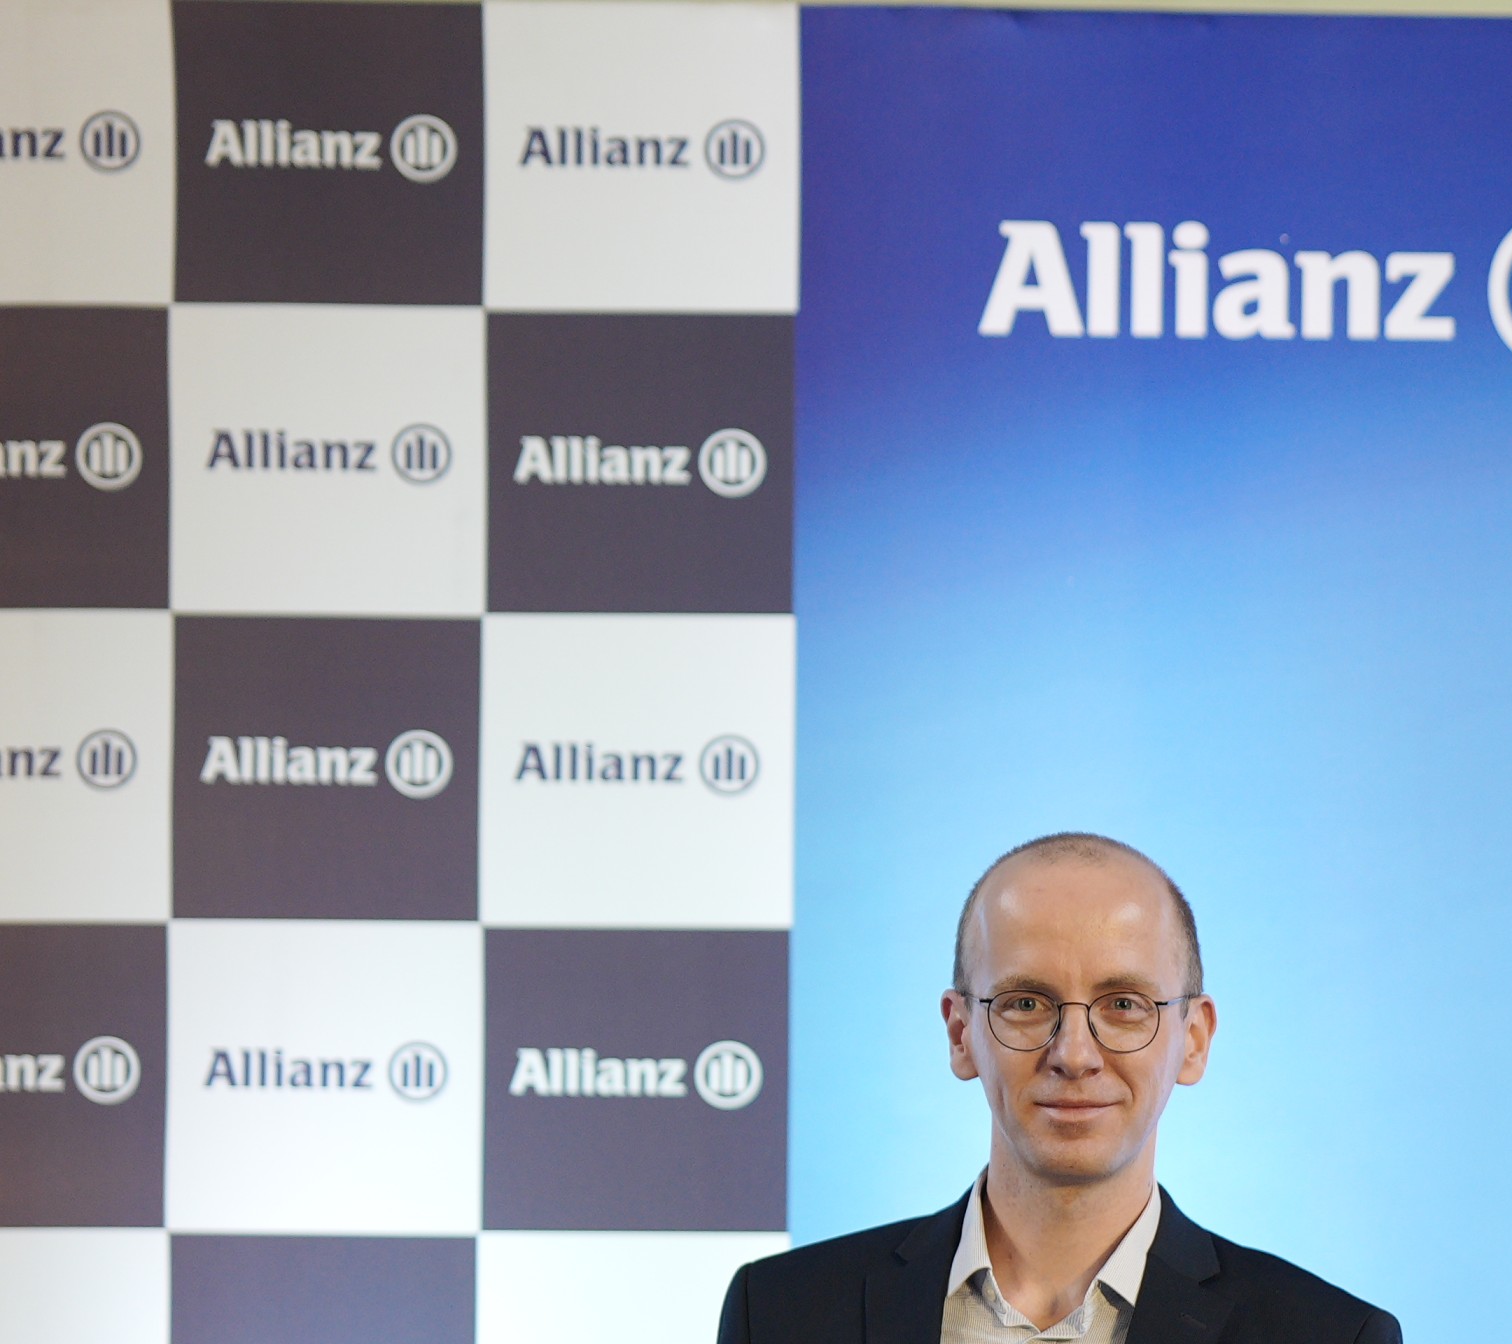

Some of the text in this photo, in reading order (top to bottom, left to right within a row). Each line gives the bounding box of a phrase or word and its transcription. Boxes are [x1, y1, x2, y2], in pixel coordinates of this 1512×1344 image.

[205, 119, 381, 170] Allianz
[519, 127, 690, 170] Allianz
[977, 219, 1456, 341] Allianz
[206, 429, 377, 472] Allianz
[513, 436, 690, 486] Allianz
[200, 736, 377, 786] Allianz
[514, 743, 684, 783] Allianz
[204, 1047, 372, 1090] Allianz
[510, 1048, 687, 1098] Allianz
